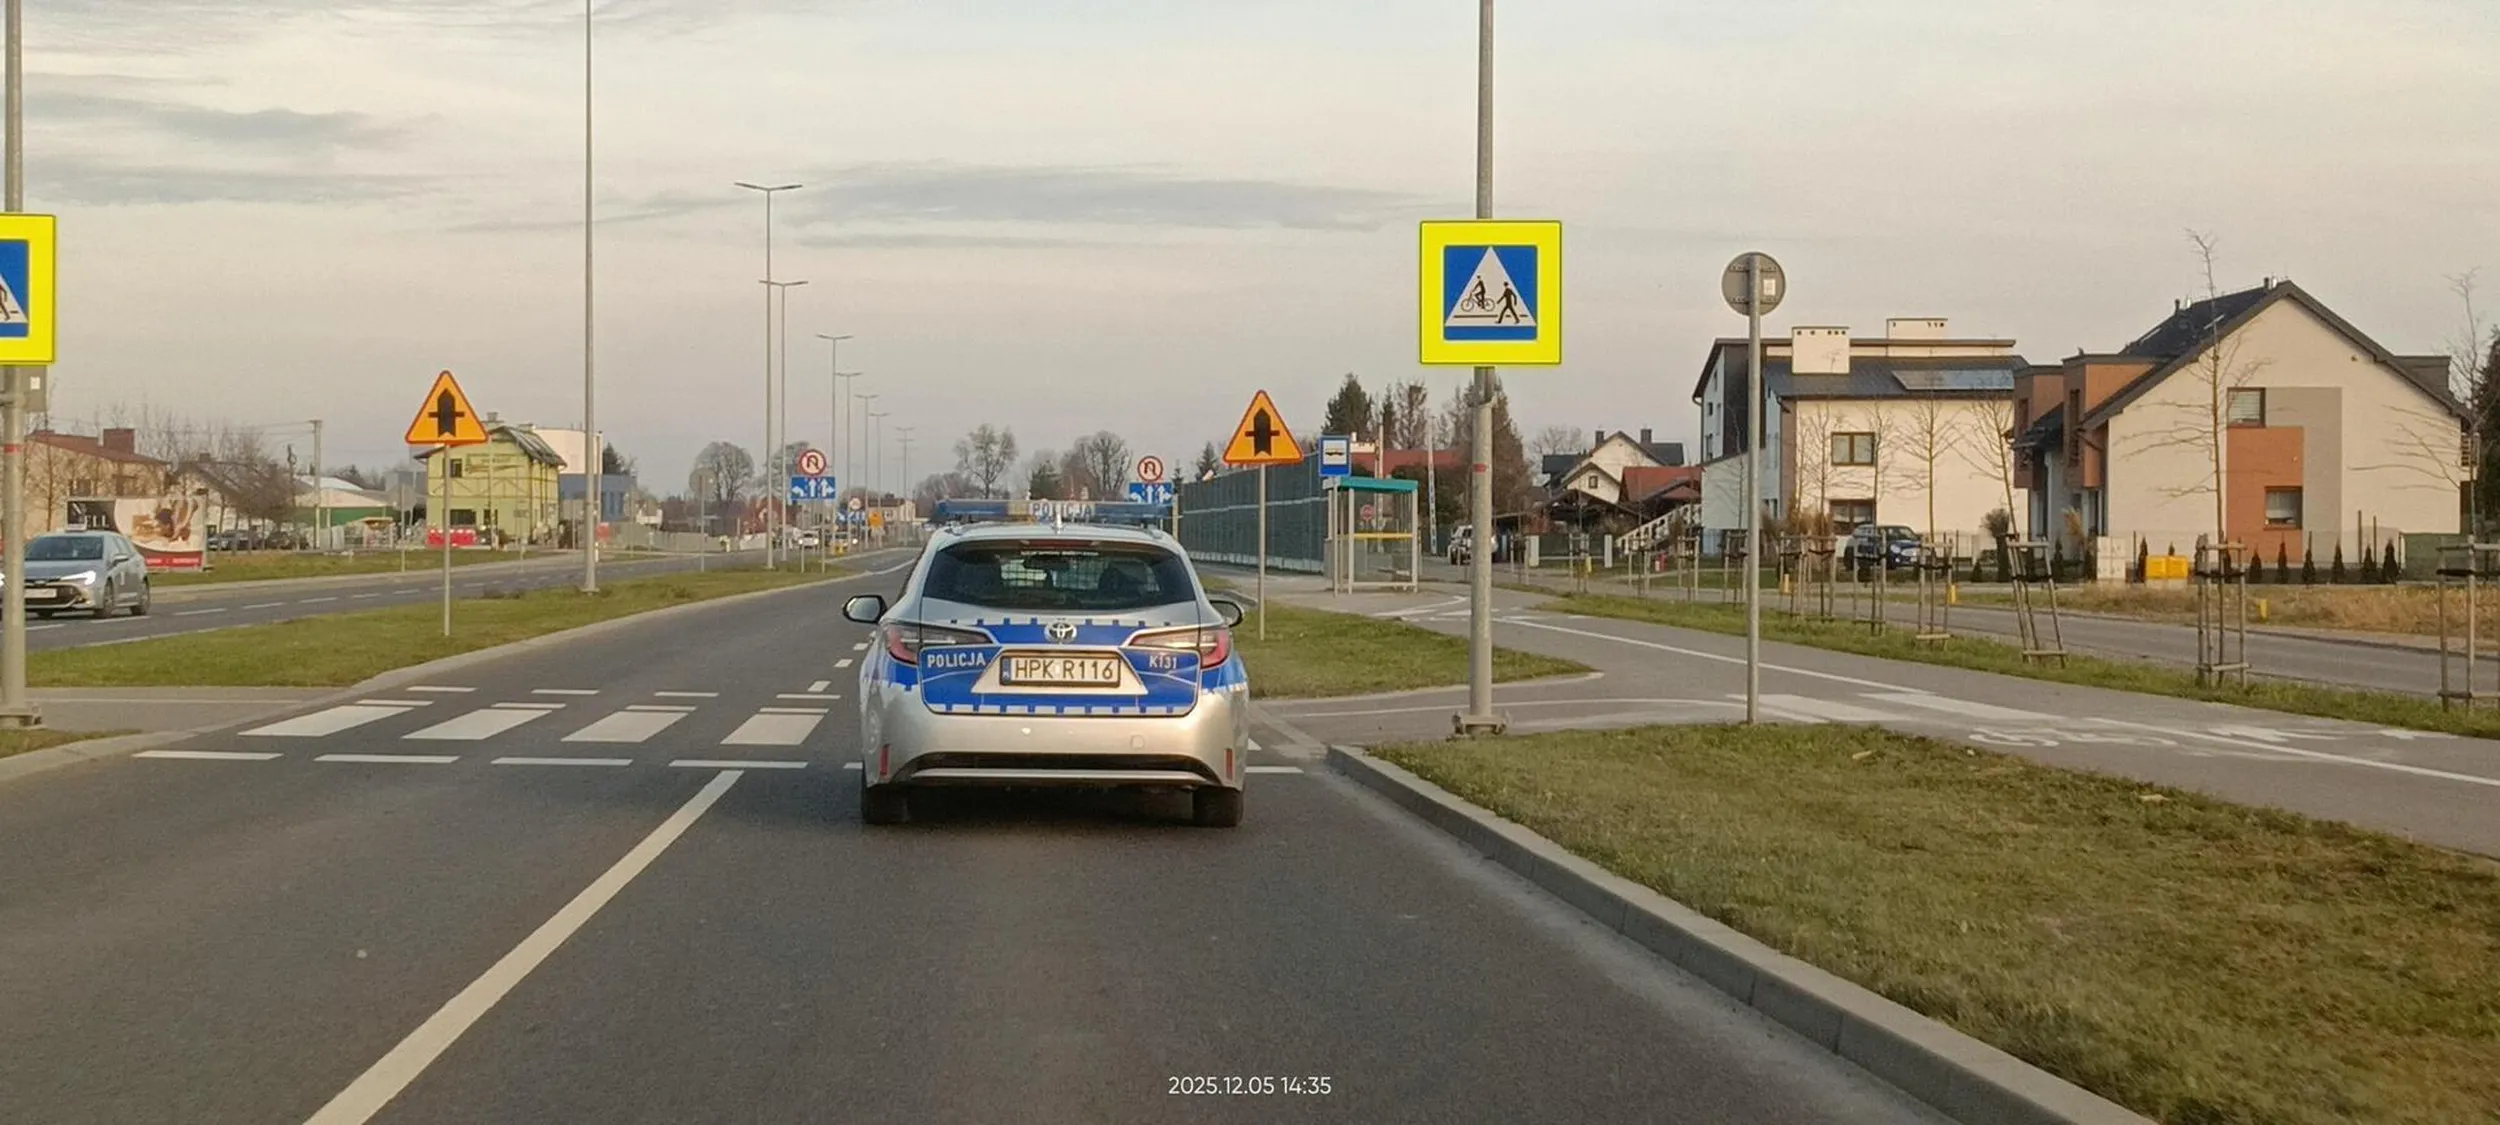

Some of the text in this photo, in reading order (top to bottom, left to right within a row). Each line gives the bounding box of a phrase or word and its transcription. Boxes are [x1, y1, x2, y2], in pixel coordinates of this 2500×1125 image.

[927, 653, 986, 668] POLICJA
[1149, 655, 1177, 669] K131
[1015, 660, 1113, 680] HPK R116
